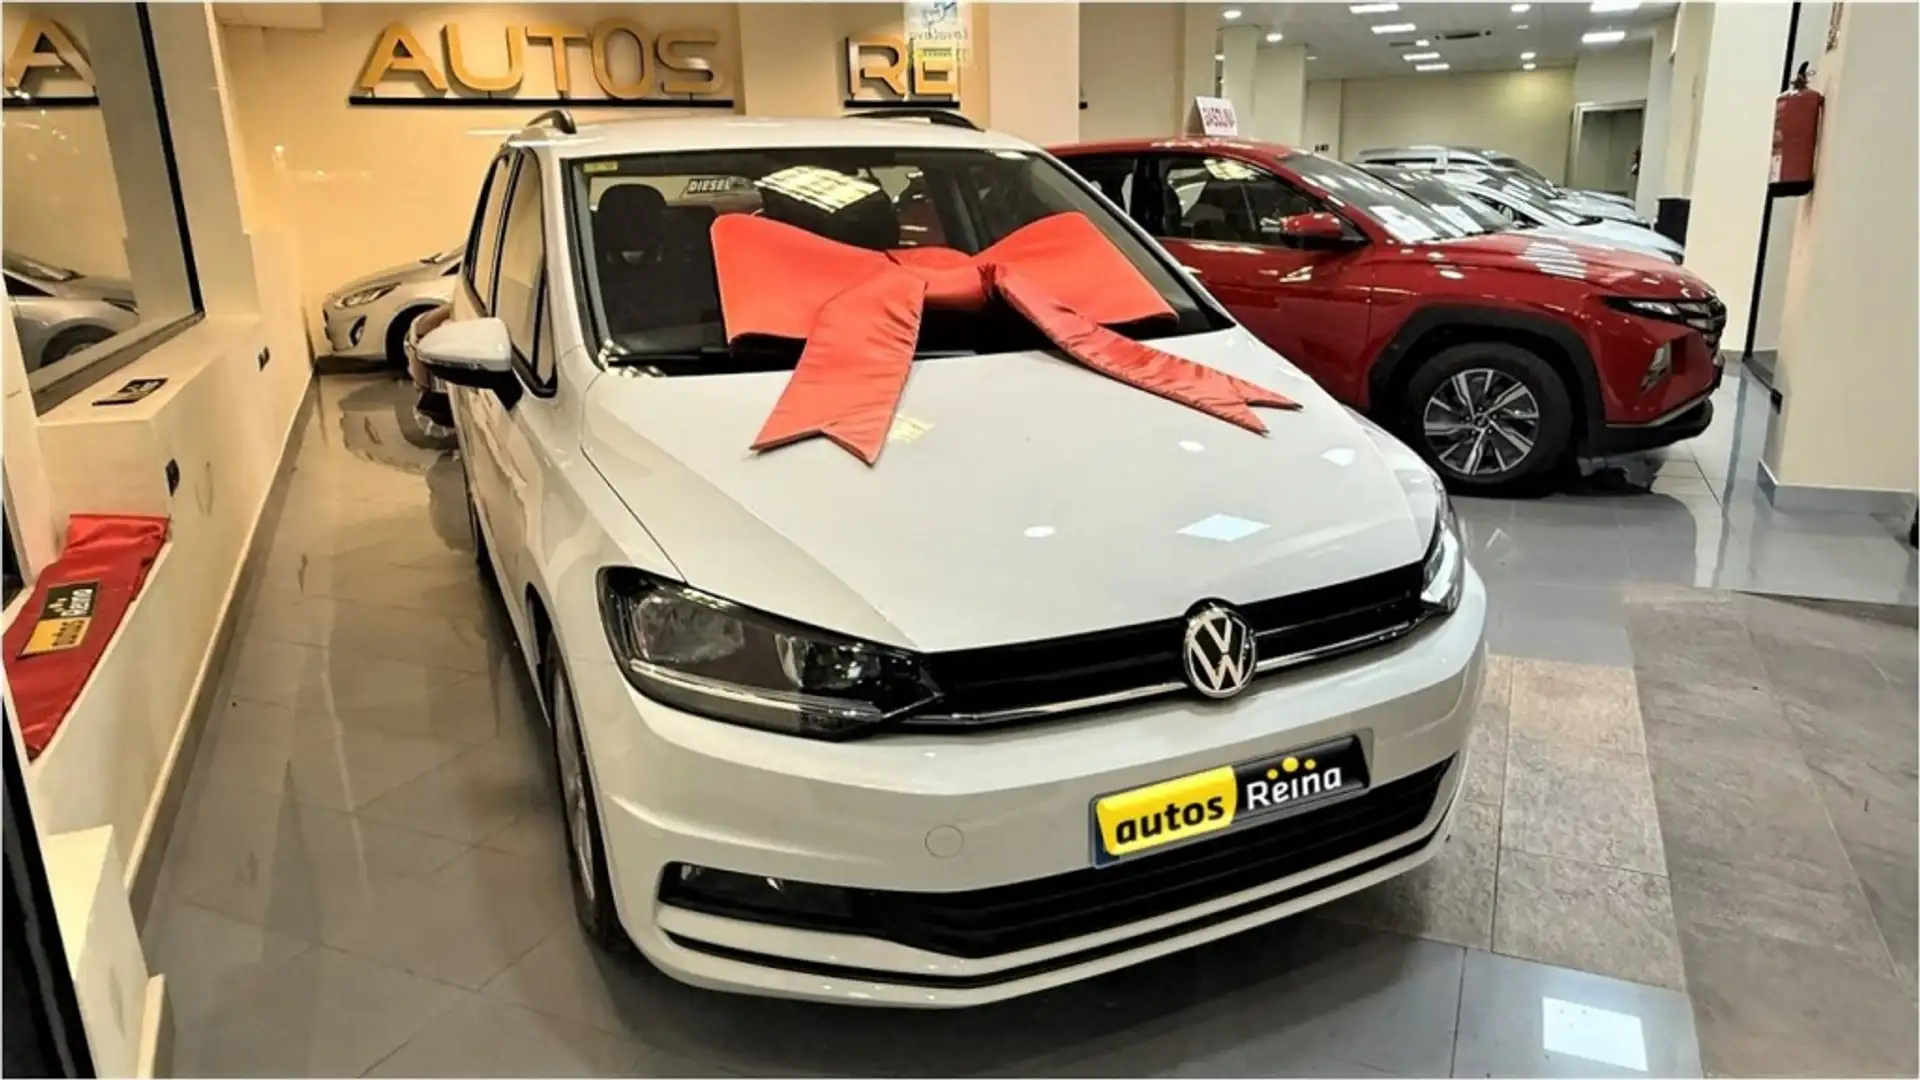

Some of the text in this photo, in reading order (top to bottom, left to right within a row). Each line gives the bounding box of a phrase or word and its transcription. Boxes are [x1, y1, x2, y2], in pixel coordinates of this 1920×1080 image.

[357, 17, 959, 99] AUTOS RE
[688, 178, 731, 193] DIESEL
[1115, 766, 1343, 846] autos Reina
